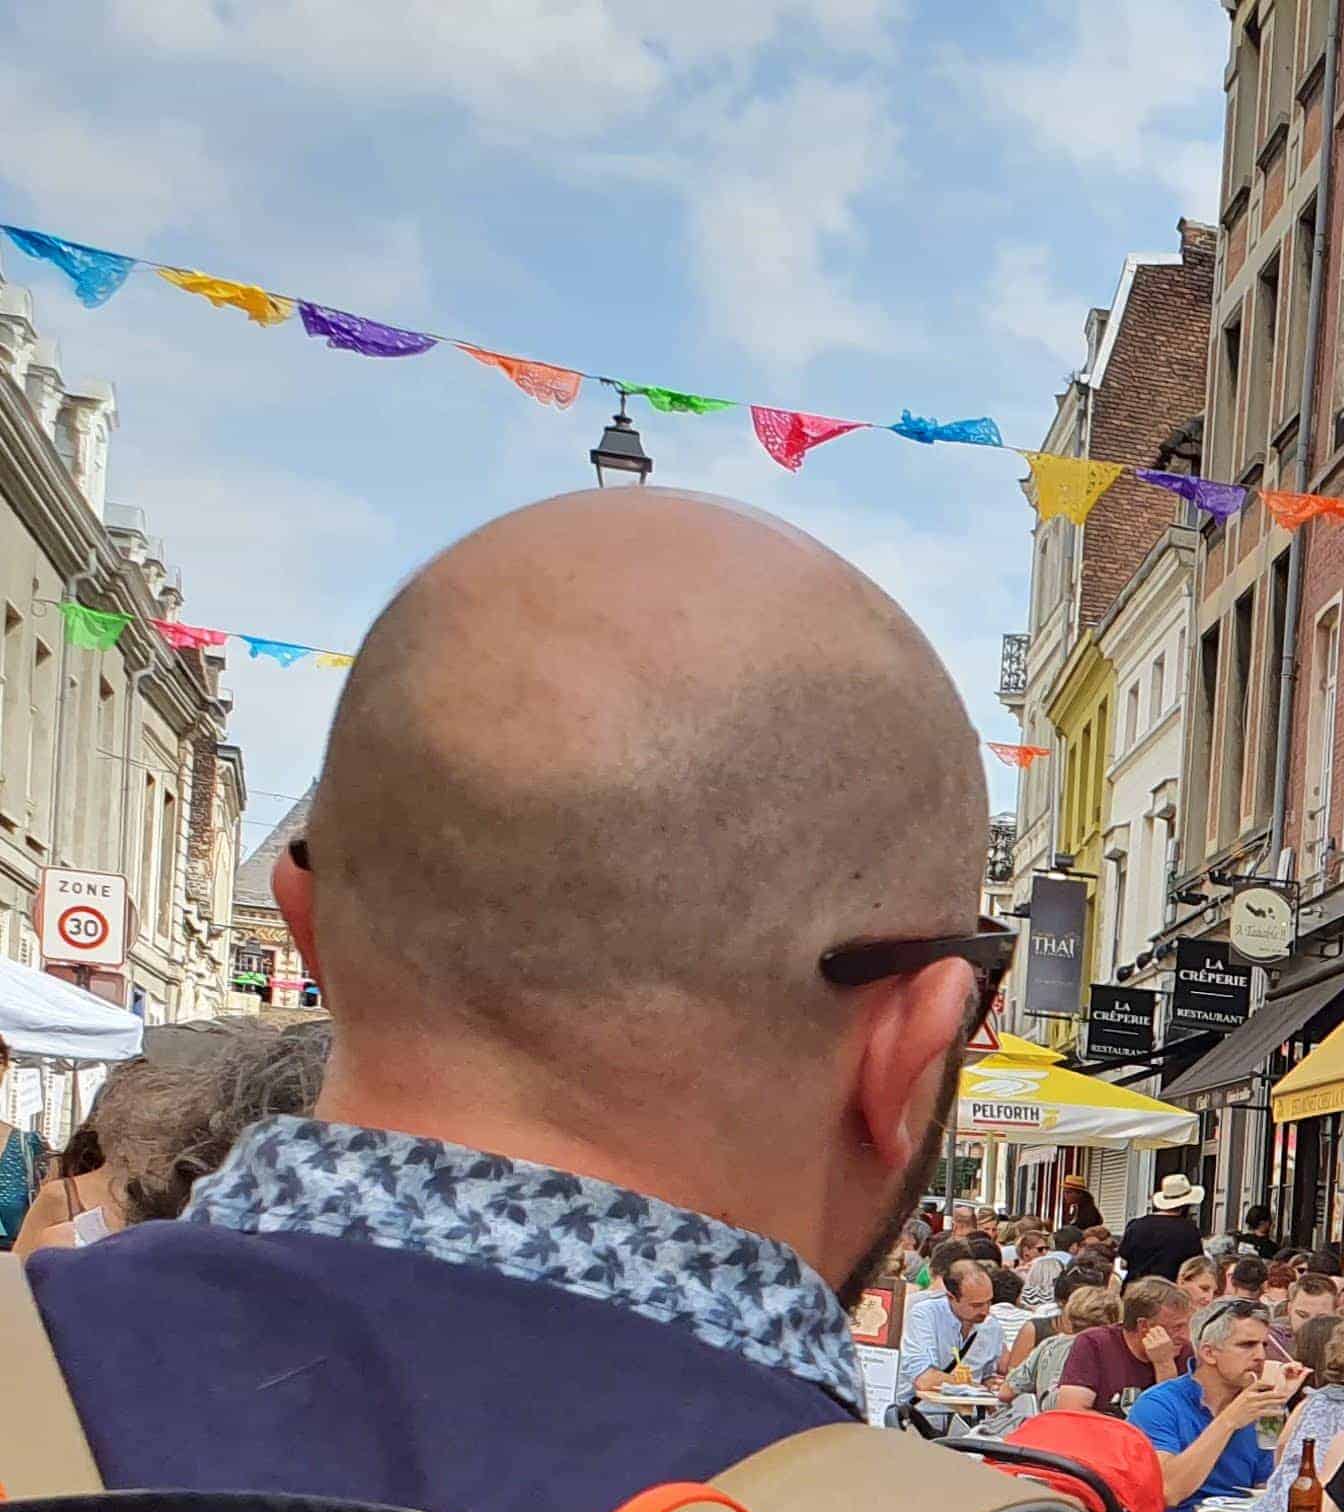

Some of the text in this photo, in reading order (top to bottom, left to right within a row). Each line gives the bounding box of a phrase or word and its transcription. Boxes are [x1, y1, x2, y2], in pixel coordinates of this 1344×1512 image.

[59, 880, 111, 898] ZONE
[69, 918, 99, 937] 30
[1205, 958, 1224, 970] LA
[1179, 967, 1248, 987] CRÊPERIE
[1114, 1000, 1131, 1012] LA
[1093, 1009, 1151, 1026] CRÊPERIE
[1176, 1007, 1245, 1025] RESTAURANT
[972, 1103, 1040, 1121] PELFORTH
